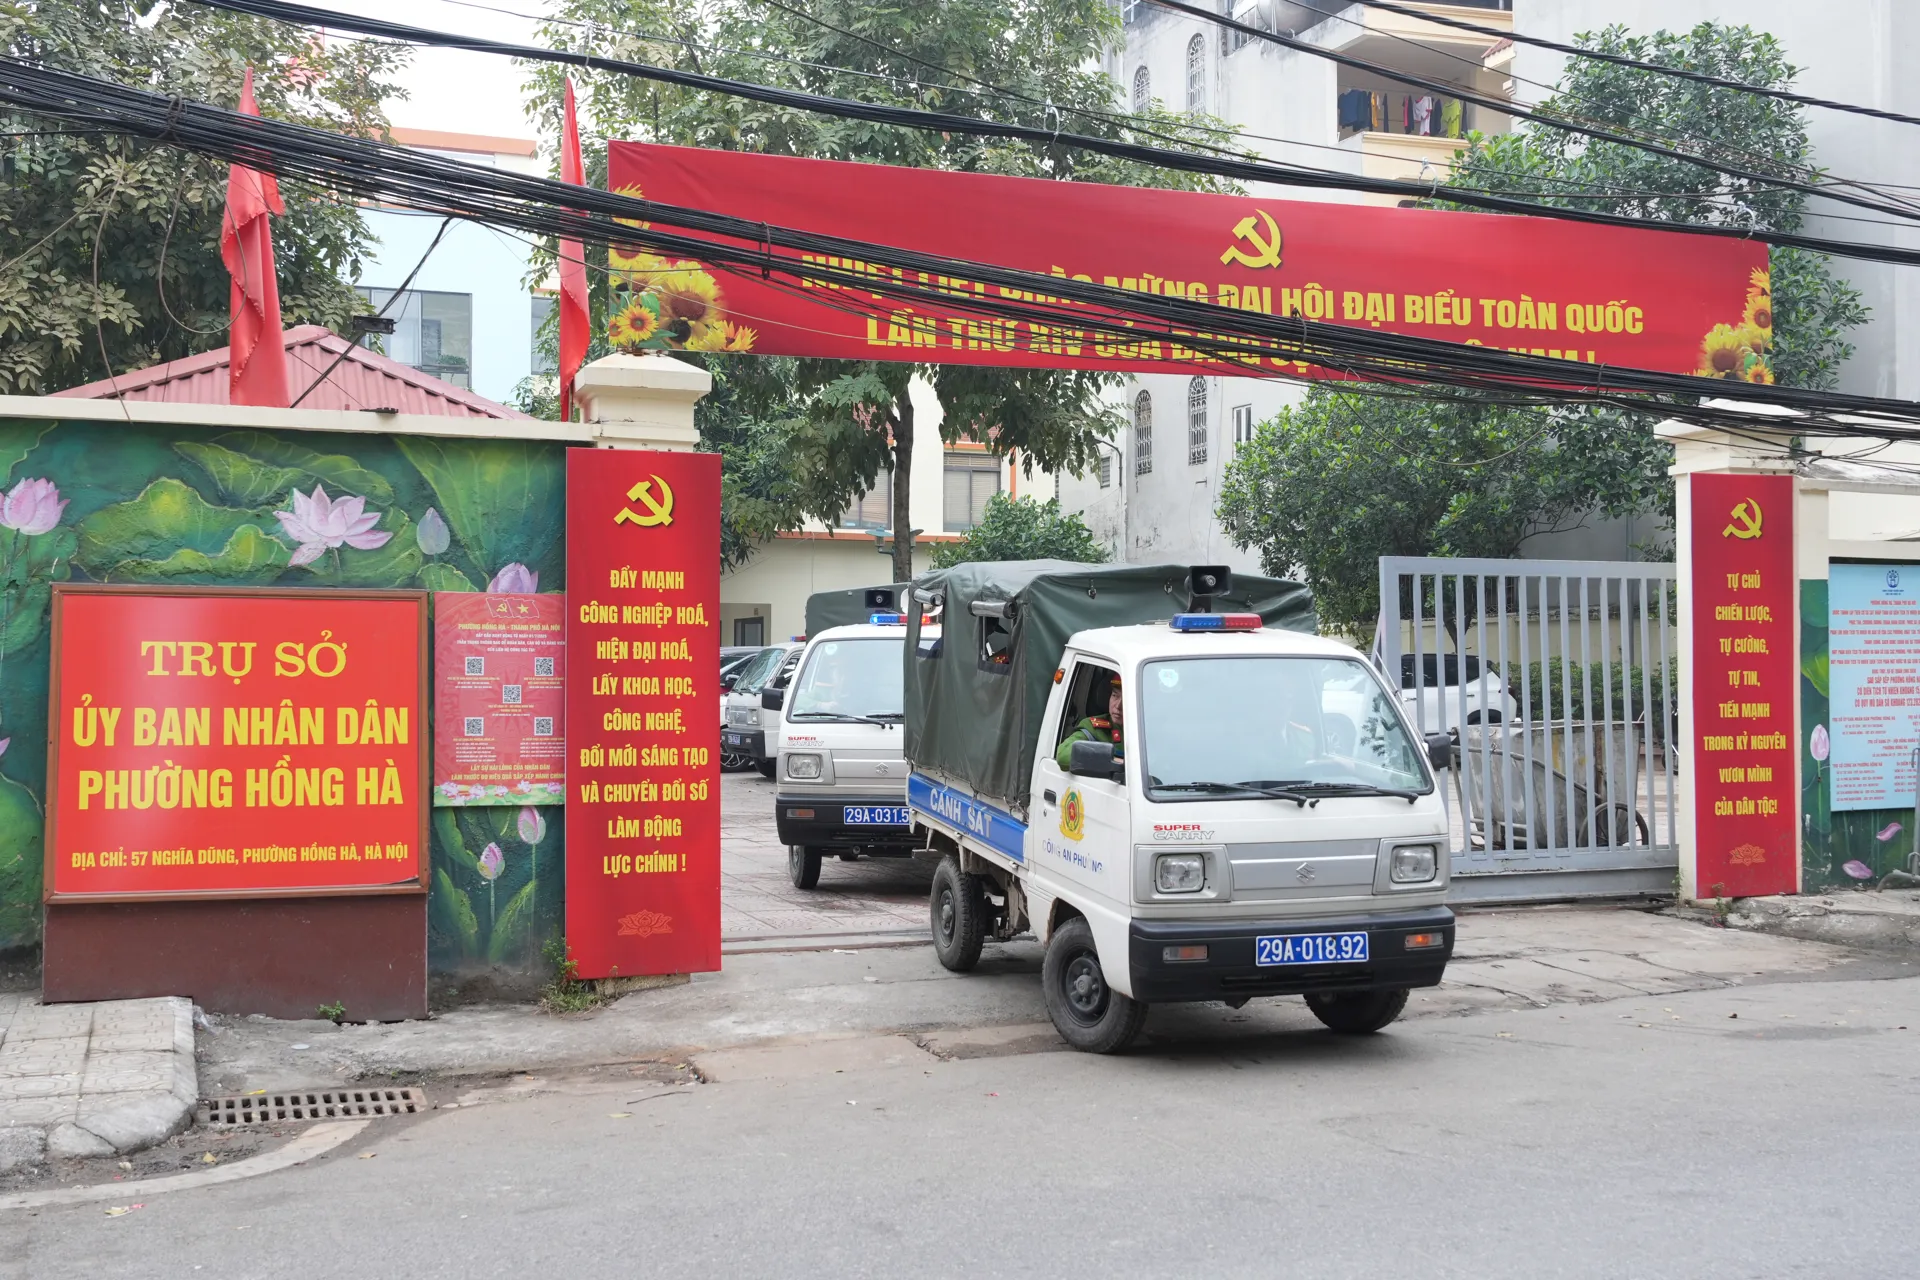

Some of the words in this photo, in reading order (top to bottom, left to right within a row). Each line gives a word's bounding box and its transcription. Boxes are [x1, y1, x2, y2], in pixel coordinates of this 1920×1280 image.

[1281, 282, 1334, 323] HỘI
[1342, 291, 1395, 327] ĐẠI
[1404, 288, 1472, 326] BIỂU
[1479, 293, 1558, 331] TOÀN
[1565, 299, 1644, 335] QUỐC
[866, 307, 937, 349] LẦN
[610, 565, 638, 589] ĐẨY
[641, 570, 685, 592] MẠNH
[1727, 572, 1739, 591] TỰ
[1742, 570, 1761, 589] CHỦ
[580, 600, 619, 624] CÔNG
[622, 602, 673, 629] NGHIỆP
[677, 603, 709, 627] HOÁ,
[1715, 602, 1743, 621] CHIẾN
[1745, 605, 1773, 623] LƯỢC,
[141, 641, 257, 685] TRỤ
[274, 630, 348, 678] SỞ
[596, 637, 629, 664] HIỆN
[632, 642, 656, 664] ĐẠI
[660, 638, 693, 662] HOÁ,
[1719, 637, 1732, 656] TỰ
[1734, 636, 1769, 654] CƯỜNG,
[593, 673, 619, 695] LẤY
[622, 677, 661, 695] KHOA
[664, 677, 697, 699] HỌC,
[1728, 671, 1740, 688] TỰ
[1743, 671, 1761, 687] TIN,
[73, 693, 122, 747] ỦY
[133, 707, 211, 746] BAN
[223, 699, 325, 746] NHÂN
[336, 698, 409, 745] DÂN
[603, 708, 642, 731] CÔNG
[645, 708, 687, 735] NGHỆ,
[1719, 700, 1739, 718] TIẾN
[1742, 703, 1770, 721] MẠNH
[1703, 736, 1734, 751] TRONG
[1736, 731, 1749, 750] KỶ
[1751, 731, 1787, 750] NGUYÊN
[580, 744, 605, 767] ĐỔI
[608, 744, 637, 767] MỚI
[641, 744, 679, 767] SÁNG
[683, 747, 709, 769] TẠO
[78, 760, 233, 810] PHƯỜNG
[245, 755, 345, 808] HỒNG
[356, 759, 404, 805] HÀ
[1719, 767, 1745, 783] VƯƠN
[1747, 766, 1773, 783] MÌNH
[580, 780, 600, 803] VÀ
[604, 779, 658, 803] CHUYỂN
[662, 779, 686, 801] ĐỔI
[689, 778, 709, 801] SỐ
[1715, 796, 1734, 816] CỦA
[1736, 796, 1755, 815] DÂN
[1758, 797, 1778, 817] TỘC!
[608, 815, 640, 839] LÀM
[643, 814, 682, 841] ĐỘNG
[1152, 831, 1215, 841] CARRY
[1153, 824, 1201, 832] SUPER
[71, 851, 96, 871] ĐỊA
[99, 847, 128, 868] CHỈ:
[131, 851, 149, 867] 57
[151, 848, 195, 866] NGHĨA
[197, 847, 240, 865] DŨNG,
[242, 844, 297, 864] PHƯỜNG
[300, 842, 337, 862] HỒNG
[340, 842, 362, 861] HÀ,
[364, 841, 383, 860] HÀ
[385, 841, 409, 862] NỘI
[603, 854, 631, 878] LỰC
[635, 849, 678, 873] CHÍNH
[1063, 848, 1072, 863] AN
[1258, 934, 1366, 963] 29A-018.92
